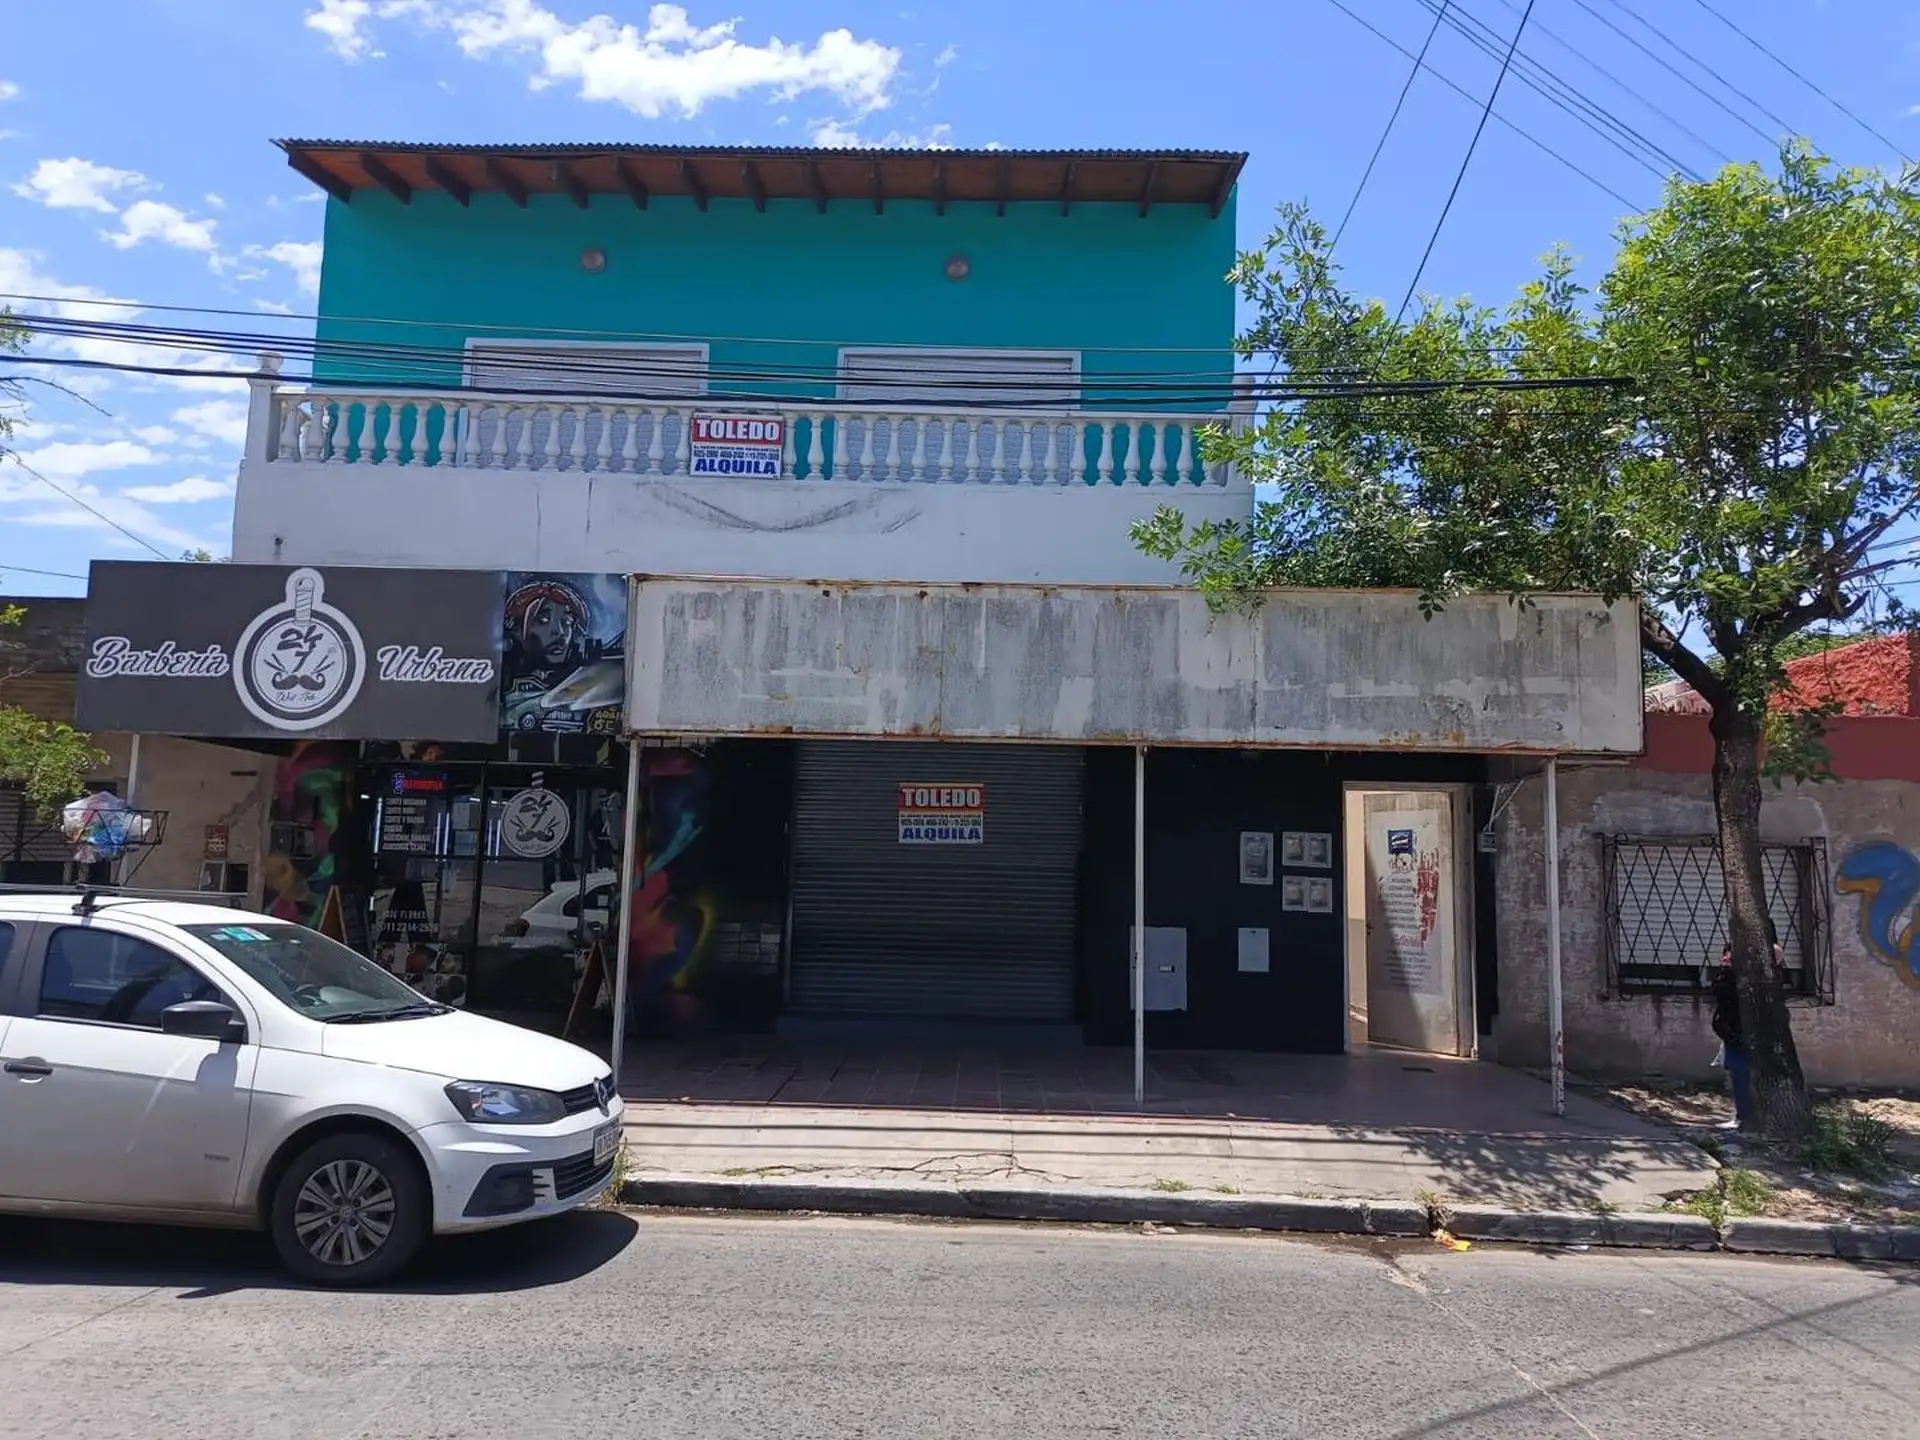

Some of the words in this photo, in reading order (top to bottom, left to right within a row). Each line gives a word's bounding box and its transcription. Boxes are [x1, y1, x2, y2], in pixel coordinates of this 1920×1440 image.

[696, 419, 779, 440] TOLEDO
[694, 458, 776, 474] ALQUILA
[377, 645, 494, 683] Urbana
[902, 788, 981, 807] TOLEDO
[902, 827, 981, 841] ALQUILA
